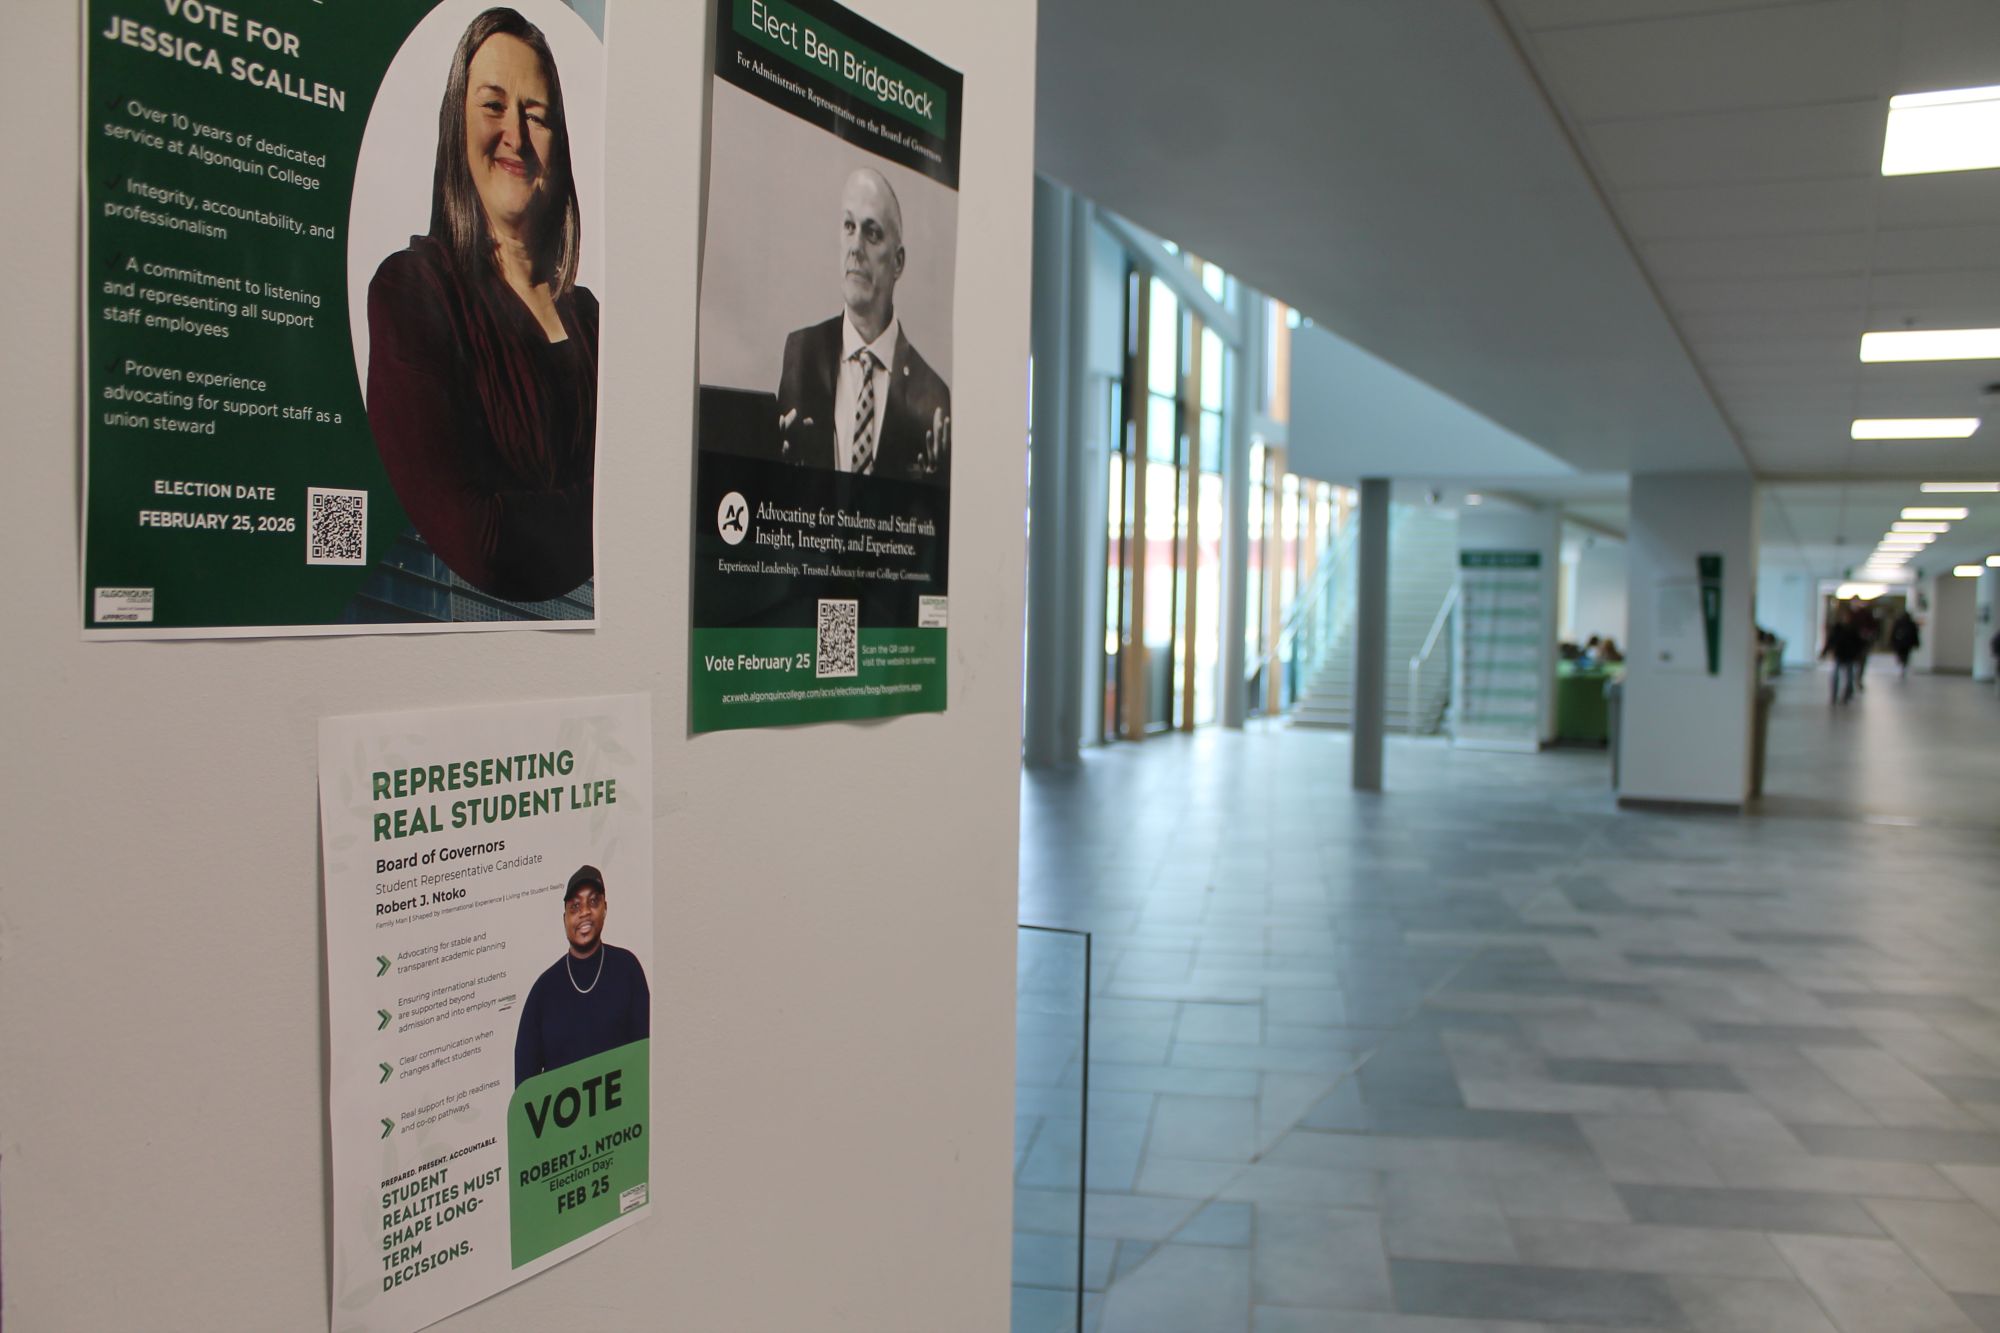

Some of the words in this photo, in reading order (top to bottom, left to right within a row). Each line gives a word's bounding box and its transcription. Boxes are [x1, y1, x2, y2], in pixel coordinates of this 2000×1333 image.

[164, 0, 239, 37] VOTE
[246, 20, 300, 58] FOR
[103, 16, 223, 75] JESSICA
[230, 56, 346, 112] SCALLEN
[751, 0, 798, 50] Elect
[804, 28, 839, 72] Ben
[843, 50, 933, 120] Bridgstock
[737, 51, 751, 69] For
[752, 60, 806, 98] Administrative
[808, 87, 855, 124] Representative
[856, 117, 866, 129] on
[867, 119, 879, 135] the
[880, 124, 902, 143] Board
[902, 136, 911, 148] of
[127, 100, 168, 125] Over
[171, 113, 189, 130] 10
[192, 123, 233, 144] years
[236, 134, 253, 148] of
[255, 138, 326, 168] dedicated
[104, 123, 164, 149] service
[168, 140, 184, 155] at
[187, 143, 264, 176] Algonquin
[267, 165, 320, 190] College
[104, 202, 228, 240] professionalism
[127, 178, 199, 211] Integrity,
[202, 199, 307, 235] accountability,
[309, 225, 335, 240] and
[125, 257, 139, 272] A
[143, 261, 241, 292] commitment
[245, 280, 260, 295] to
[264, 282, 321, 309] listening
[103, 280, 136, 298] and
[139, 288, 237, 318] representing
[241, 303, 257, 319] all
[261, 308, 314, 329] support
[103, 306, 142, 325] staff
[145, 313, 230, 339] employees
[125, 360, 182, 382] Proven
[186, 370, 267, 392] experience
[103, 385, 193, 411] advocating
[198, 394, 219, 411] for
[223, 399, 279, 417] support
[282, 406, 312, 422] staff
[316, 410, 330, 423] as
[333, 413, 342, 424] a
[104, 411, 149, 429] union
[153, 415, 216, 435] steward
[154, 479, 232, 498] ELECTION
[235, 485, 276, 501] DATE
[139, 510, 229, 530] FEBRUARY
[231, 515, 255, 533] 25,
[257, 516, 296, 533] 2026
[756, 501, 816, 528] Advocating
[818, 507, 835, 526] for
[837, 509, 876, 531] Students
[877, 515, 894, 533] and
[895, 516, 917, 534] Staff
[917, 519, 936, 537] with
[755, 526, 795, 549] Insight,
[798, 530, 846, 554] Integrity,
[847, 535, 864, 551] and
[866, 536, 916, 557] Experience.
[718, 558, 760, 575] Experienced
[761, 560, 801, 578] Leadership.
[802, 563, 829, 577] Trusted
[876, 567, 899, 581] College
[705, 655, 735, 672] Vote
[737, 653, 793, 673] February
[795, 653, 811, 669] 25
[862, 645, 877, 654] Scan
[878, 645, 888, 654] the
[889, 645, 897, 653] QR
[372, 750, 574, 801] REPRESENTING
[373, 805, 444, 842] REAL
[451, 787, 564, 829] STUDENT
[570, 779, 617, 810] LIFE
[375, 853, 418, 874] Board
[421, 848, 436, 865] of
[439, 838, 506, 861] Governors
[375, 877, 418, 896] Student
[420, 862, 495, 886] Representative
[495, 853, 543, 872] Candidate
[375, 898, 417, 916] Robert
[420, 895, 430, 907] J.
[432, 887, 467, 905] Ntoko
[375, 921, 394, 929] Family
[412, 912, 432, 922] Shaped
[441, 902, 473, 914] International
[474, 896, 502, 907] Experience
[530, 886, 549, 895] Student
[397, 944, 439, 960] Advocating
[440, 941, 450, 950] for
[450, 937, 472, 948] stable
[473, 931, 487, 942] and
[397, 957, 439, 975] transparent
[441, 947, 475, 962] academic
[475, 941, 506, 955] planning
[397, 991, 431, 1007] Ensuring
[431, 978, 476, 998] international
[477, 970, 507, 985] students
[398, 1009, 410, 1020] are
[411, 998, 448, 1018] supported
[449, 991, 476, 1006] beyond
[398, 1016, 435, 1034] admission
[436, 1011, 450, 1021] and
[451, 1006, 465, 1017] into
[399, 1053, 418, 1066] Clear
[419, 1036, 474, 1060] communication
[475, 1029, 494, 1041] when
[399, 1064, 430, 1079] changes
[431, 1055, 451, 1069] affect
[451, 1046, 482, 1061] students
[400, 1108, 417, 1121] Real
[418, 1099, 445, 1114] support
[446, 1095, 456, 1104] for
[456, 1091, 467, 1102] job
[468, 1079, 500, 1096] readiness
[401, 1121, 416, 1134] and
[416, 1116, 437, 1129] co-op
[438, 1103, 470, 1121] pathways
[524, 1069, 622, 1139] VOTE
[381, 1169, 417, 1189] PREPARED.
[418, 1156, 448, 1173] PRESENT.
[449, 1137, 497, 1161] ACCOUNTABLE.
[520, 1149, 577, 1187] ROBERT
[579, 1145, 592, 1161] J.
[595, 1123, 642, 1155] NTOKO
[382, 1168, 448, 1209] STUDENT
[550, 1167, 590, 1192] Election
[592, 1157, 614, 1173] Day:
[383, 1184, 459, 1230] REALITIES
[463, 1167, 502, 1195] MUST
[557, 1185, 586, 1215] FEB
[591, 1175, 609, 1199] 25
[382, 1216, 432, 1250] SHAPE
[436, 1197, 484, 1226] LONG-
[382, 1240, 422, 1271] TERM
[383, 1240, 474, 1292] DECISIONS.
